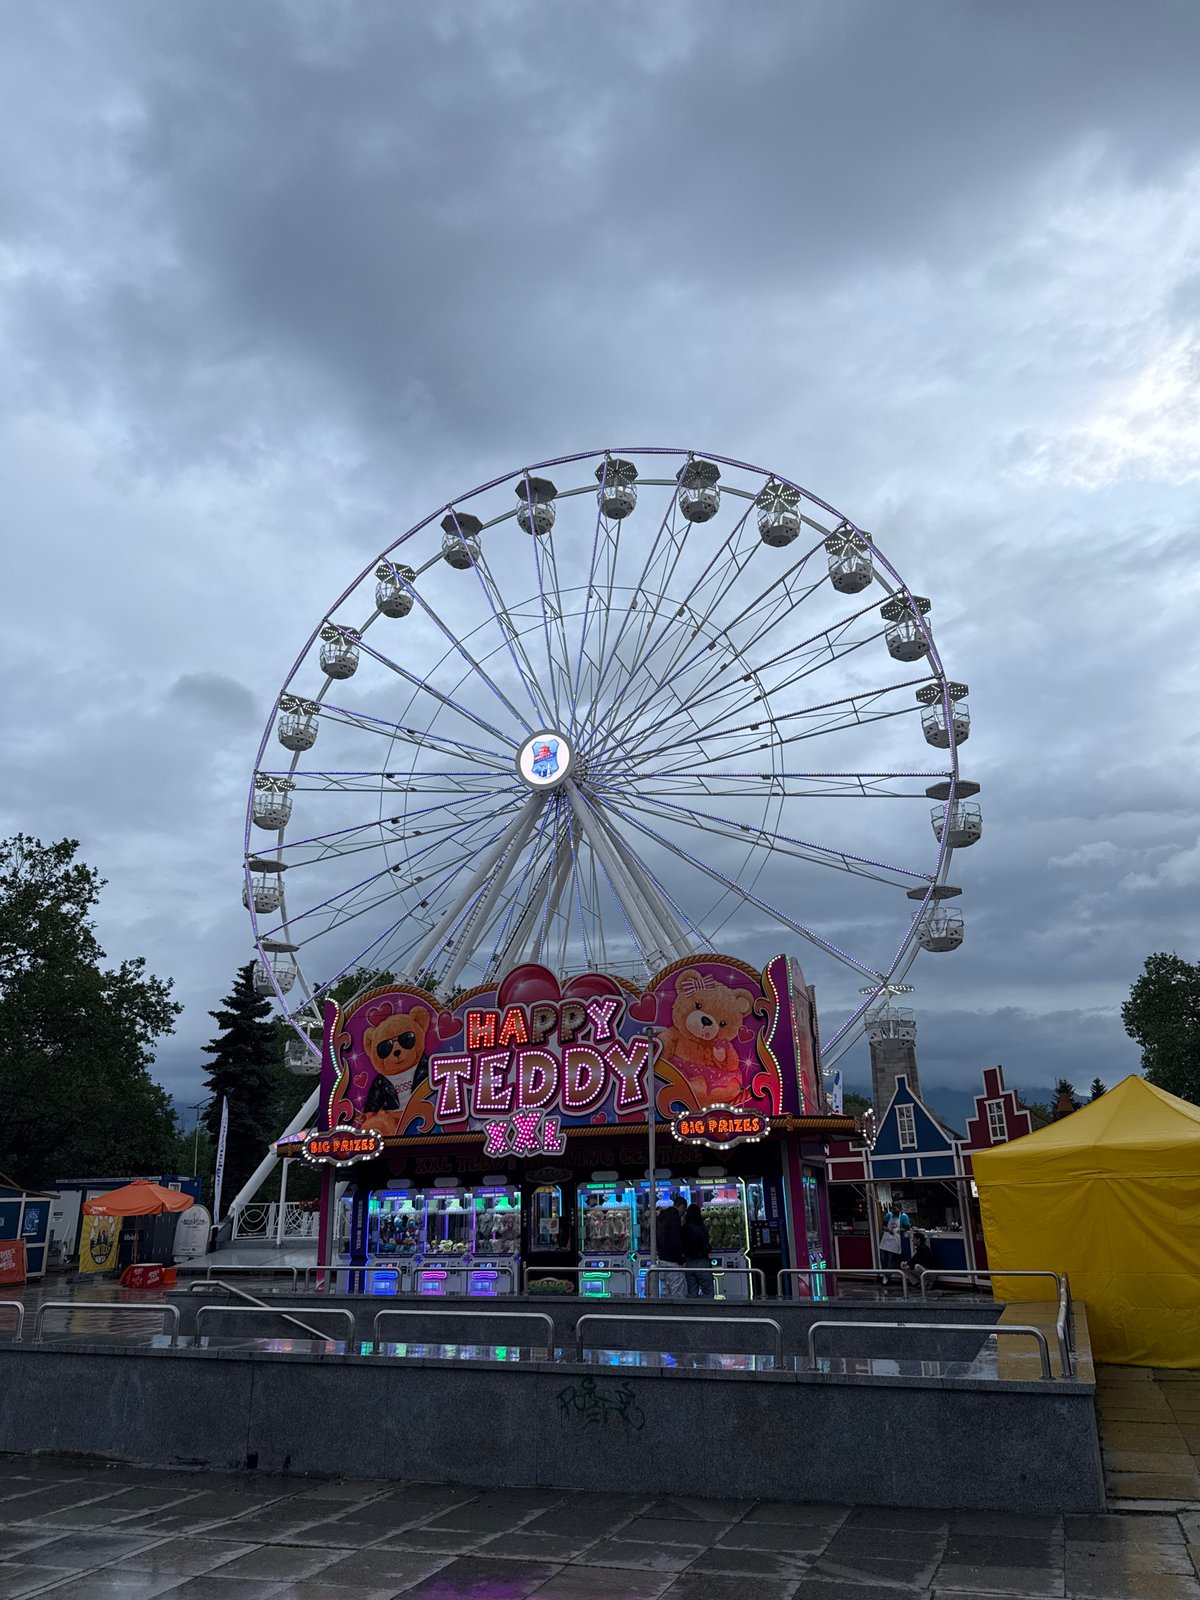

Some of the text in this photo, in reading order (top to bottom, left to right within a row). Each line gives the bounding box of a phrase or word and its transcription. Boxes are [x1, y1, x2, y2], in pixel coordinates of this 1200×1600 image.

[468, 1001, 619, 1050] HAPPY
[395, 1080, 413, 1094] BOSS
[433, 1041, 651, 1116] TEDDY
[485, 1111, 563, 1154] XXL
[680, 1117, 760, 1135] BIG PRIZES
[310, 1137, 375, 1153] BIG PRIZES
[415, 1157, 453, 1174] XXL
[456, 1155, 517, 1173] TEDDY
